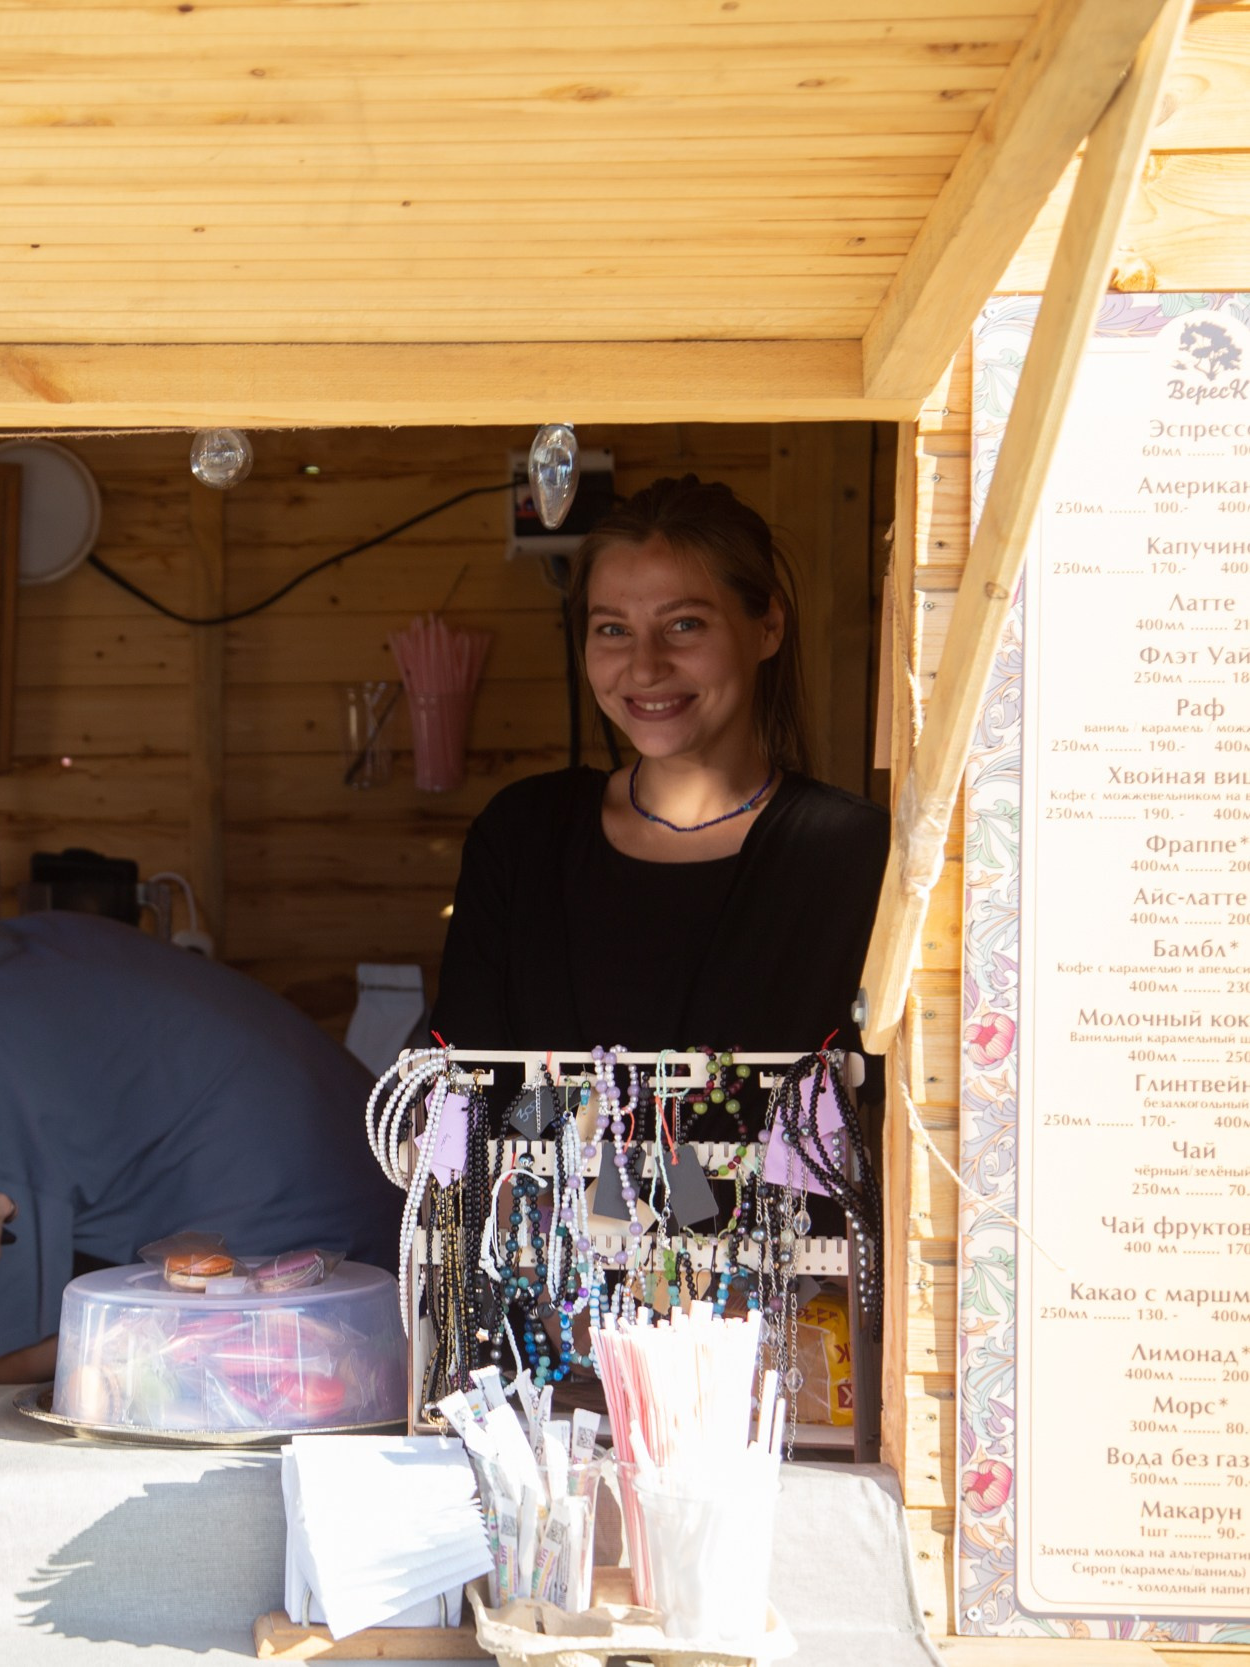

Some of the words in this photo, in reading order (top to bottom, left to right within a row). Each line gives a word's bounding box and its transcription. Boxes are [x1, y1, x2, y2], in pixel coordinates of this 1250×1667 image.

[1149, 420, 1250, 440] Эспресс
[1142, 445, 1181, 457] 60мл
[1232, 445, 1250, 457] 10
[1055, 502, 1103, 514] 250мл
[1218, 502, 1250, 514] 400
[1147, 537, 1250, 559] Капучин
[1053, 562, 1102, 574] 250мл
[1169, 593, 1236, 612] Латте
[1135, 618, 1185, 631] 400мл
[1140, 646, 1198, 665] Флэт
[1134, 671, 1182, 684] 250мл
[1176, 697, 1225, 721] Раф
[1141, 725, 1203, 735] карамель
[1051, 740, 1100, 752] 250мл
[1108, 766, 1206, 785] Хвойная
[1050, 790, 1087, 802] Кофе
[1103, 793, 1221, 801] можжевельником
[1045, 807, 1094, 820] 250мл
[1130, 860, 1180, 872] 400мл
[1133, 887, 1247, 906] Айс-латте
[1129, 912, 1179, 925] 400мл
[1057, 962, 1093, 975] Кофе
[1109, 964, 1182, 975] карамелью
[1129, 980, 1178, 993] 400мл
[1077, 1008, 1202, 1028] Молочный
[1211, 1014, 1249, 1028] кок
[1070, 1032, 1142, 1042] Ванильный
[1147, 1033, 1236, 1045] карамельный
[1128, 1050, 1177, 1062] 400мл
[1135, 1074, 1250, 1093] Глинтвейн
[1143, 1097, 1249, 1109] безалкогольный
[1043, 1114, 1091, 1126] 250мл
[1172, 1140, 1216, 1159] Чай
[1131, 1183, 1180, 1195] 250мл
[1101, 1215, 1145, 1234] Чай
[1153, 1216, 1250, 1239] фруктов
[1124, 1241, 1152, 1253] 400
[1070, 1282, 1136, 1301] Какао
[1145, 1289, 1157, 1301] с
[1165, 1289, 1250, 1306] маршм
[1040, 1307, 1088, 1319] 250мл
[1125, 1368, 1174, 1380] 400мл
[1129, 1420, 1178, 1433] 300мл
[1107, 1447, 1163, 1467] Вода
[1172, 1448, 1208, 1467] без
[1217, 1453, 1249, 1468] газ
[1130, 1472, 1178, 1485] 500мл
[1140, 1501, 1241, 1524] Макарун
[1139, 1526, 1168, 1538] 1шт
[1039, 1544, 1089, 1557] Замена
[1094, 1547, 1144, 1558] молока
[1149, 1549, 1165, 1558] на
[1072, 1562, 1116, 1576] Сироп
[1137, 1582, 1206, 1596] холодный
